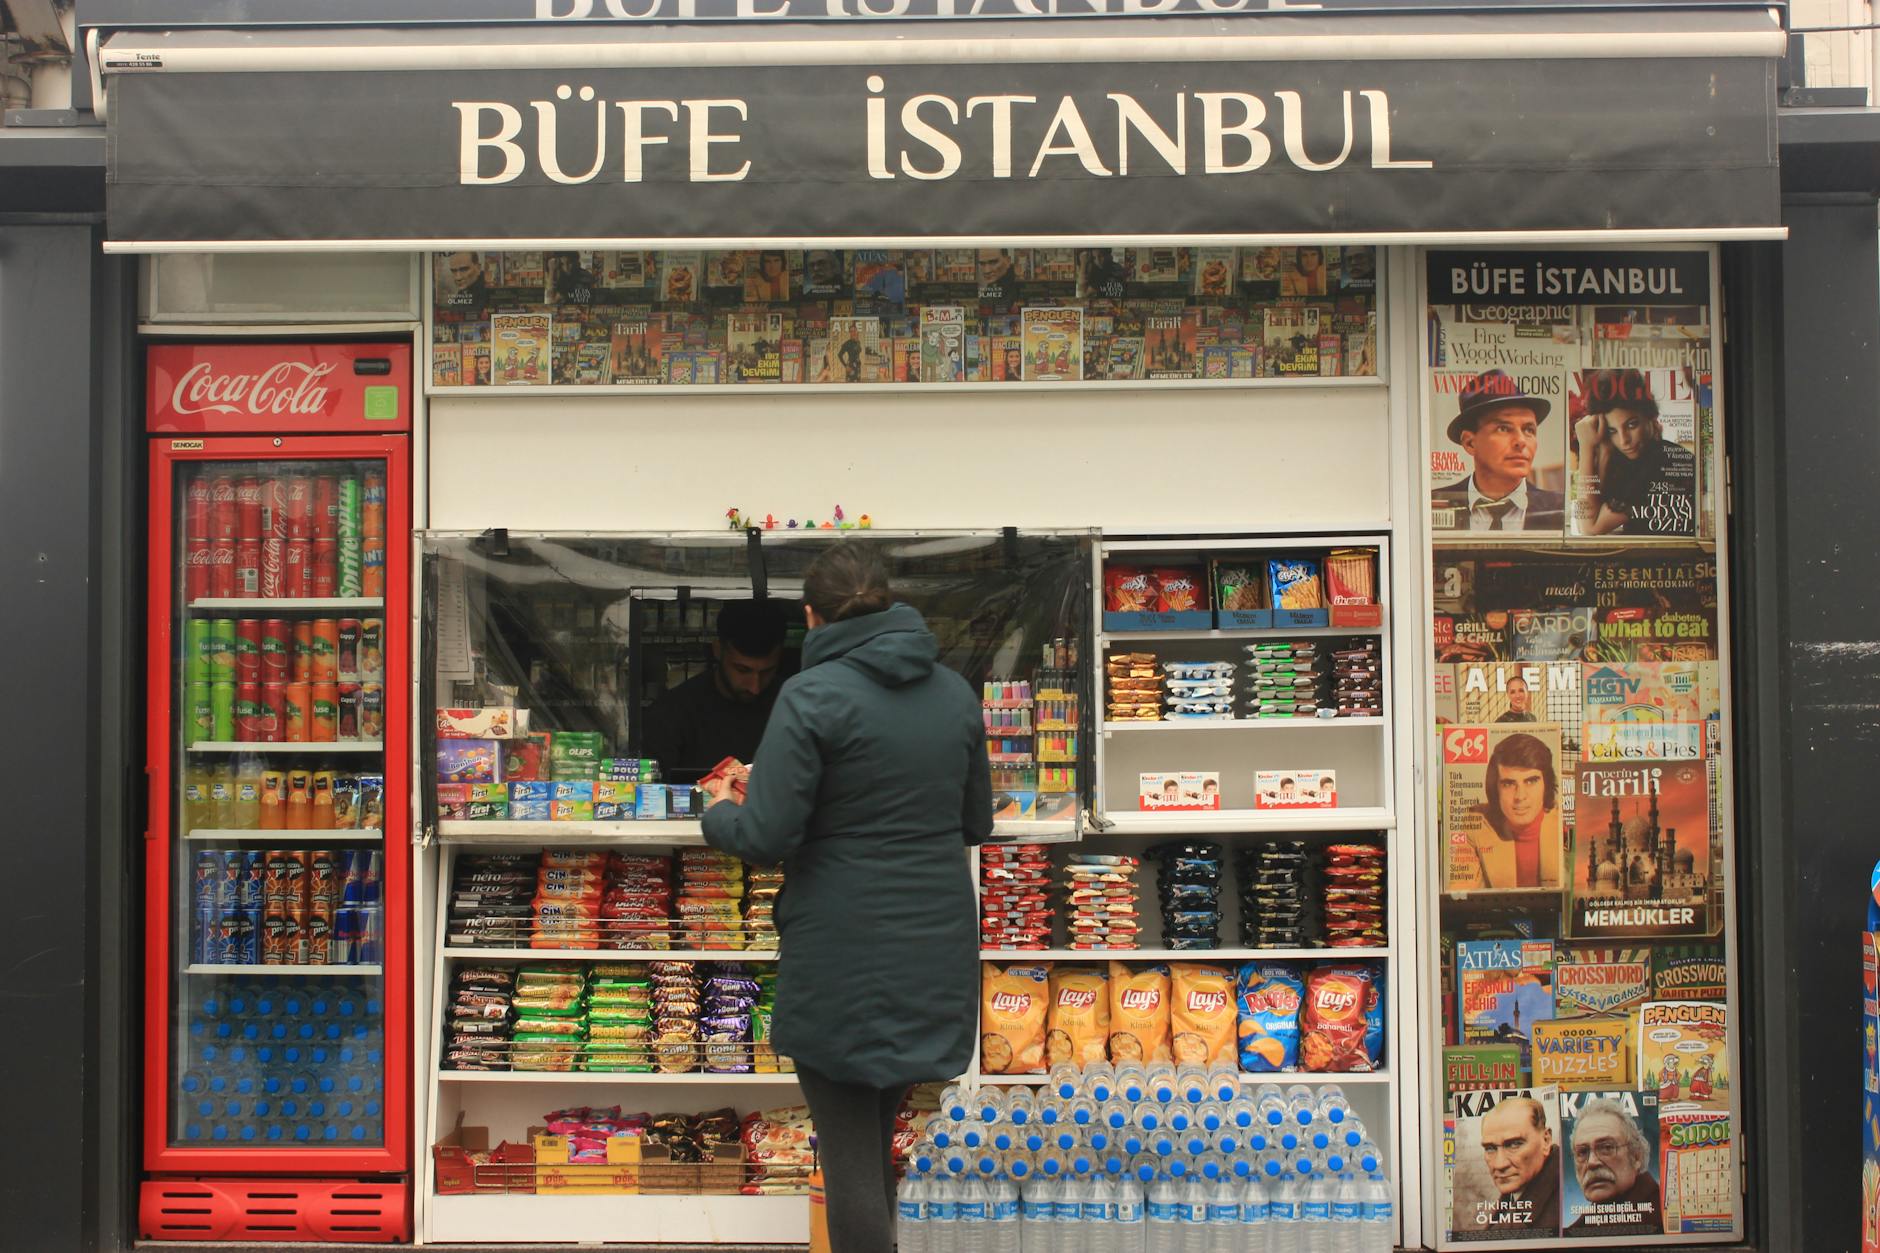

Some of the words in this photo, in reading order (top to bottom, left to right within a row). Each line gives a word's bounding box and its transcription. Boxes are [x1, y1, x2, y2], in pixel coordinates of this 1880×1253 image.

[452, 84, 753, 186] BÜFE
[866, 75, 1434, 181] İSTANBUL
[1450, 262, 1525, 295] BÜFE
[1536, 262, 1683, 295] İSTANBUL
[495, 317, 549, 329] PENGUEN
[1024, 310, 1080, 322] PENGUEN
[1465, 304, 1573, 326] Geographic
[1474, 327, 1507, 344] Fine
[742, 368, 780, 377] DEVRİMİ
[1279, 363, 1318, 371] DEVRİMİ
[172, 361, 339, 415] Coca-Cola
[1517, 375, 1560, 396] ICONS
[1572, 369, 1692, 401] VOGUE
[340, 539, 362, 598] Sprite
[1594, 567, 1695, 581] ESSENTIAL
[1455, 622, 1489, 633] GRILL
[1600, 619, 1652, 638] what
[1654, 619, 1675, 638] to
[1677, 619, 1710, 638] eat
[1455, 632, 1466, 643] &
[1466, 632, 1504, 643] CHILL
[1465, 667, 1577, 692] ALEM
[1587, 678, 1642, 694] HGTV
[1592, 740, 1644, 758] Cakes
[1645, 741, 1660, 757] &
[1662, 741, 1697, 758] Pies
[613, 766, 639, 774] POLO
[1449, 771, 1463, 780] Türk
[472, 788, 488, 797] First
[556, 787, 574, 796] First
[598, 788, 616, 797] First
[470, 803, 491, 816] First
[556, 805, 574, 814] First
[597, 805, 618, 817] First
[472, 873, 502, 882] nero
[1584, 906, 1694, 927] MEMLÛKLER
[1462, 949, 1521, 969] ATLAS
[1559, 965, 1643, 985] CROSSWORD
[722, 983, 740, 992] Gong
[1660, 988, 1699, 999] VARIETY
[668, 992, 686, 1000] Gong
[993, 991, 1029, 1013] Lay's
[1059, 988, 1097, 1008] Lay's
[1123, 987, 1159, 1011] Lay's
[1189, 990, 1226, 1013] Lay's
[1316, 990, 1355, 1012] Lay's
[1559, 984, 1645, 1010] EXTRAVAGANZA
[1643, 1004, 1726, 1025] PENGUEN
[708, 1044, 736, 1055] Gong
[1536, 1034, 1622, 1055] VARIETY
[1539, 1052, 1619, 1075] PUZZLES
[1476, 1200, 1533, 1211] FİKİRLER
[1476, 1211, 1533, 1225] ÖLMEZ
